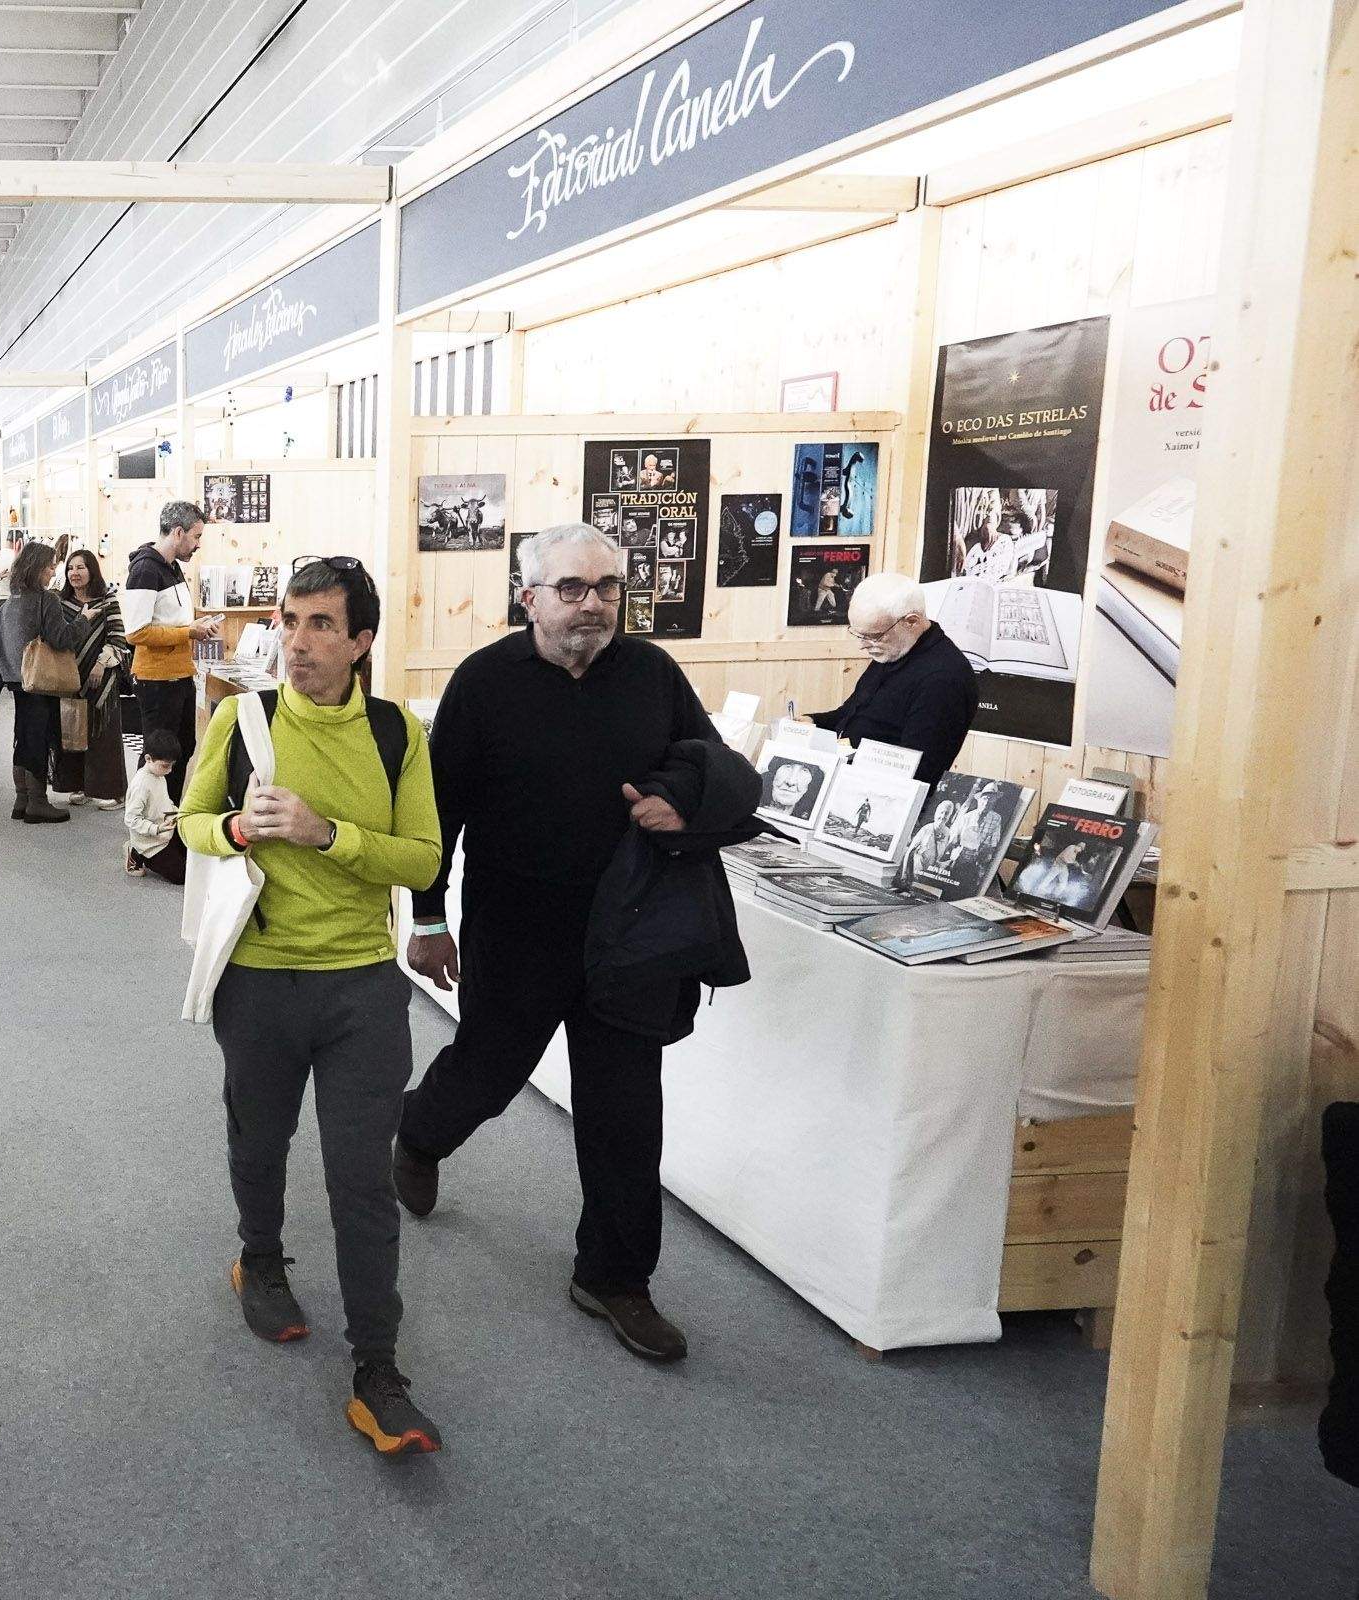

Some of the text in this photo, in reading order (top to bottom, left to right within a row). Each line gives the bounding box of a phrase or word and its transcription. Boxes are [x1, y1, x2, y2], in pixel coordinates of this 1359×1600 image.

[506, 16, 856, 240] Editorial Canela
[1149, 382, 1177, 412] de
[942, 405, 1088, 434] O ECO DAS ESTRELAS
[1042, 428, 1072, 438] Santiago
[621, 489, 698, 506] TRADICIÓN
[659, 505, 697, 518] ORAL
[823, 550, 862, 562] FERRO
[1073, 818, 1124, 840] FERRO
